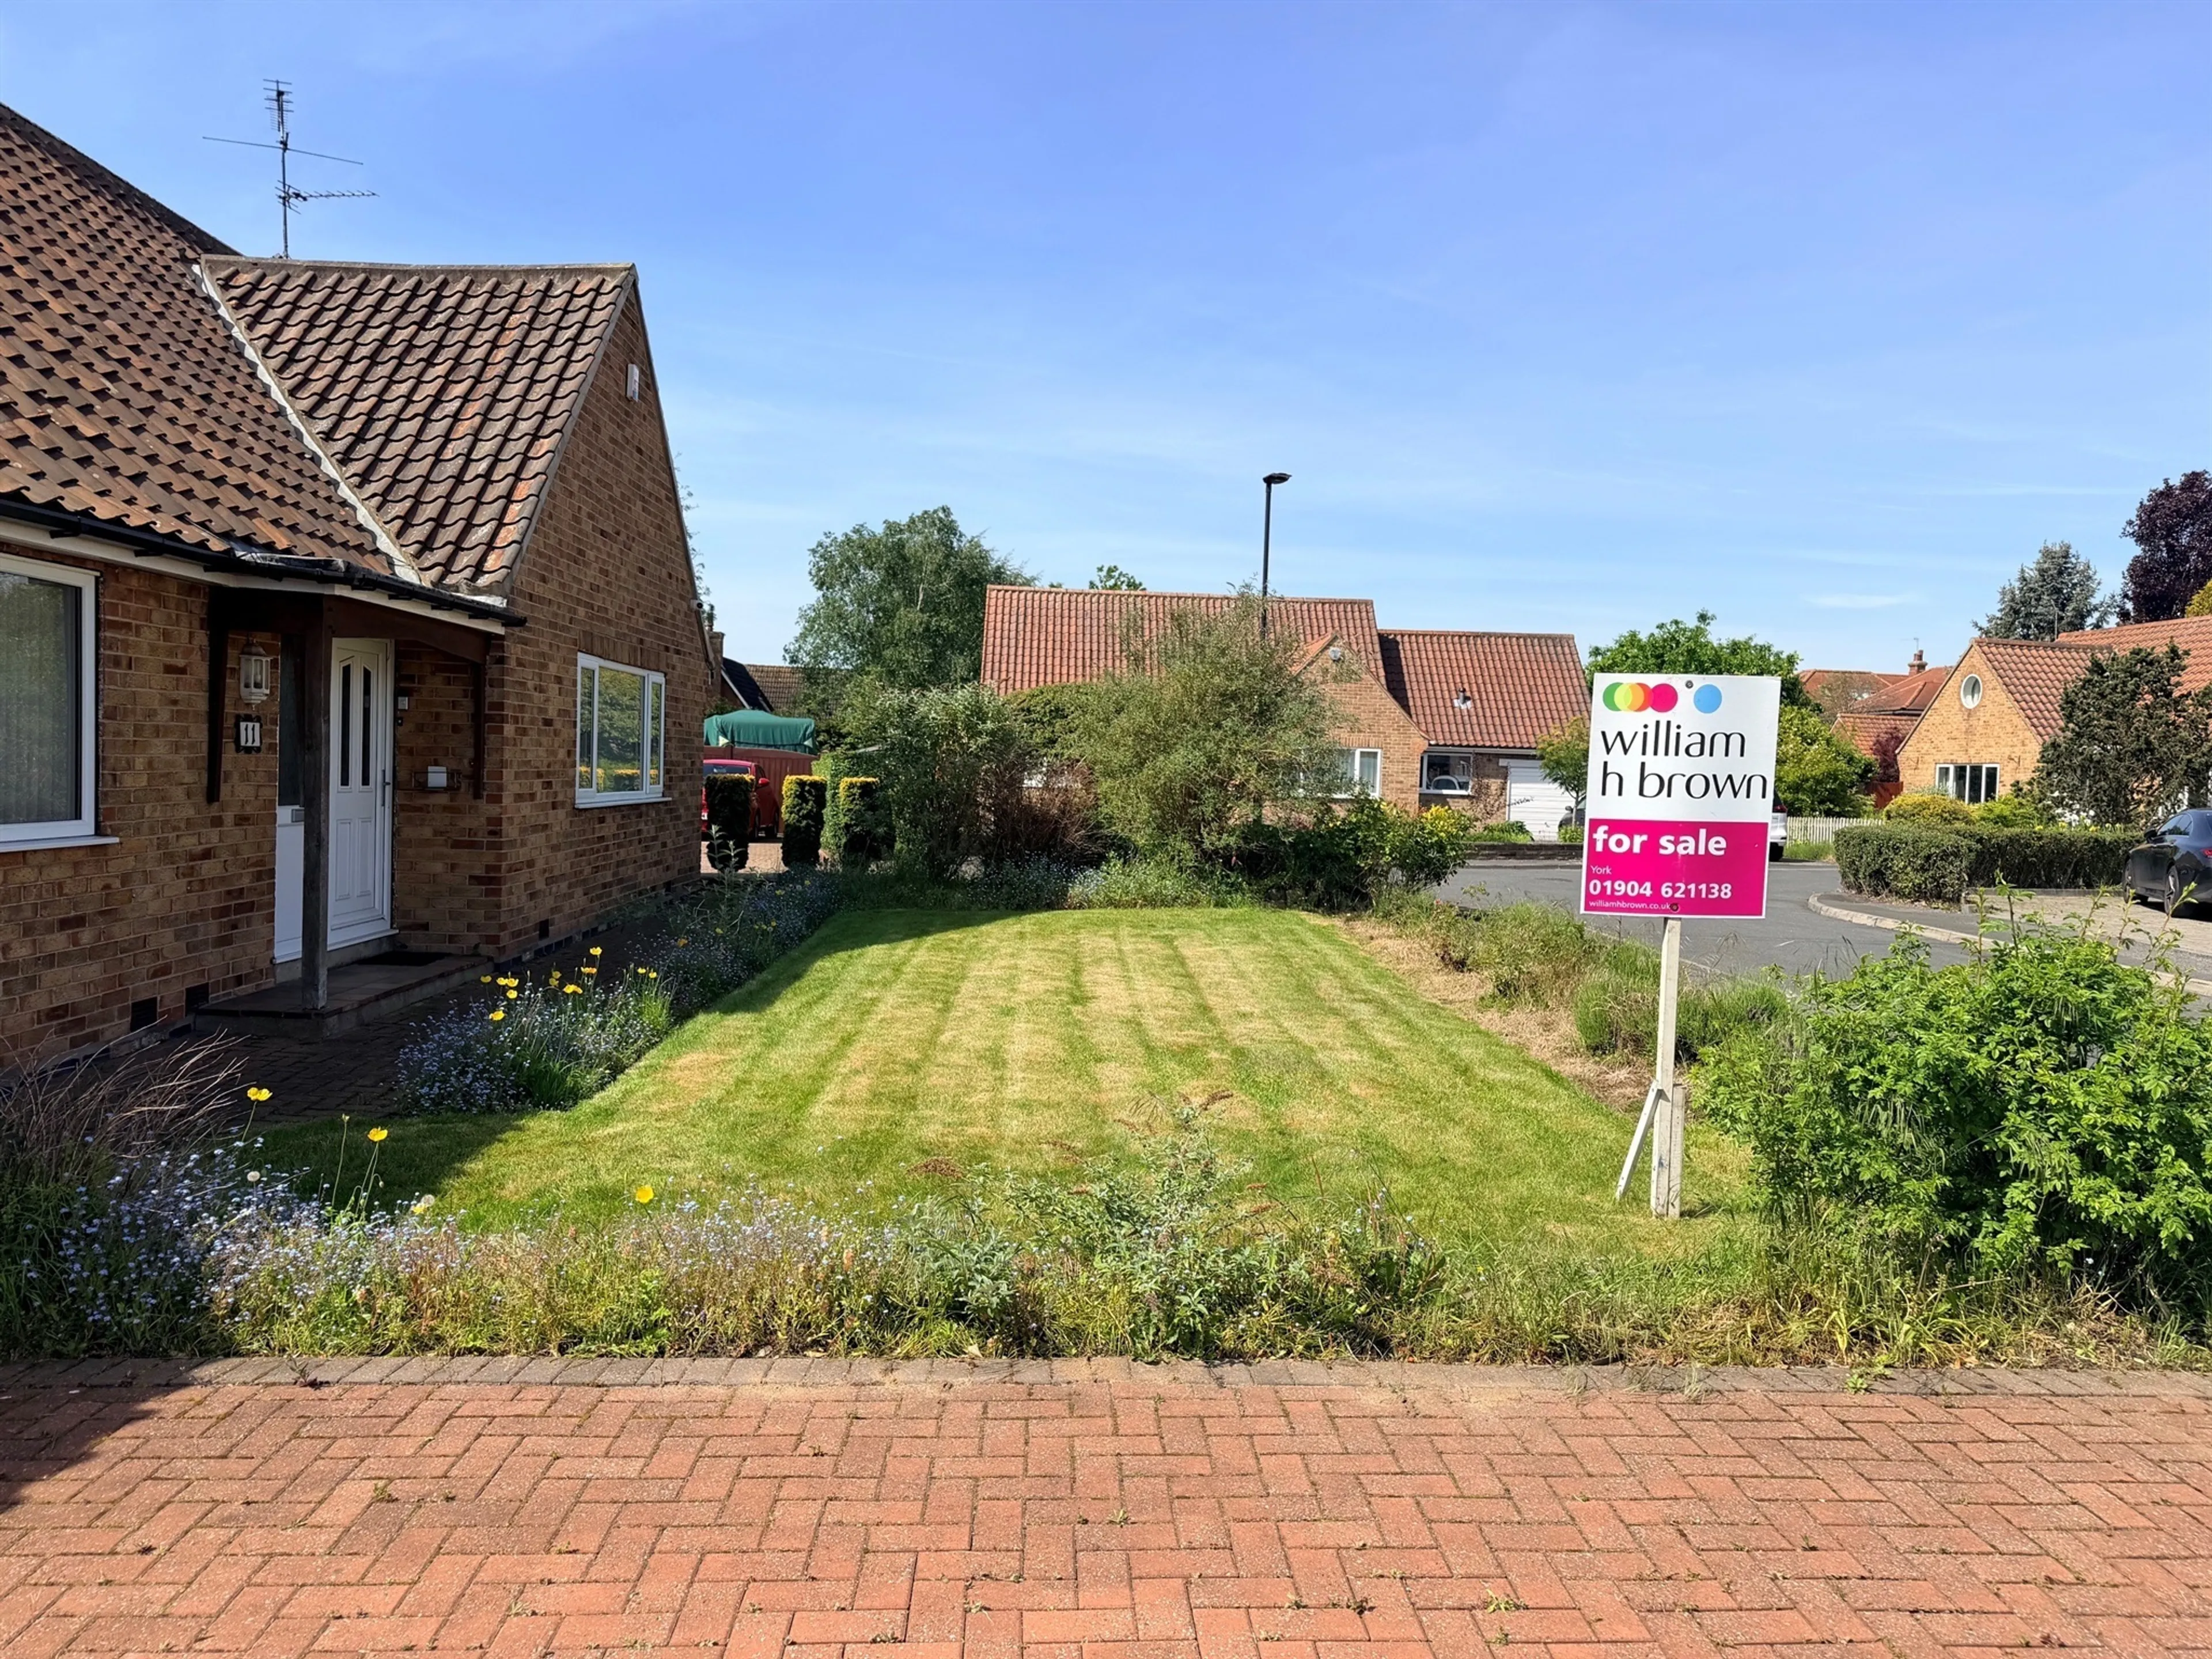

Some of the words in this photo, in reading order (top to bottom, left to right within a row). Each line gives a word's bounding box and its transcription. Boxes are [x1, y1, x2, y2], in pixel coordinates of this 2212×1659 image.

[244, 724, 255, 745] 11
[1601, 720, 1745, 757] william
[1601, 761, 1623, 796] h
[1638, 762, 1767, 799] brown
[1593, 825, 1647, 853] for
[1659, 828, 1727, 855] sale
[1590, 865, 1612, 874] York
[1589, 879, 1653, 897] 01904
[1661, 882, 1732, 899] 621138
[1589, 900, 1671, 910] williamhbrown.co.uk
